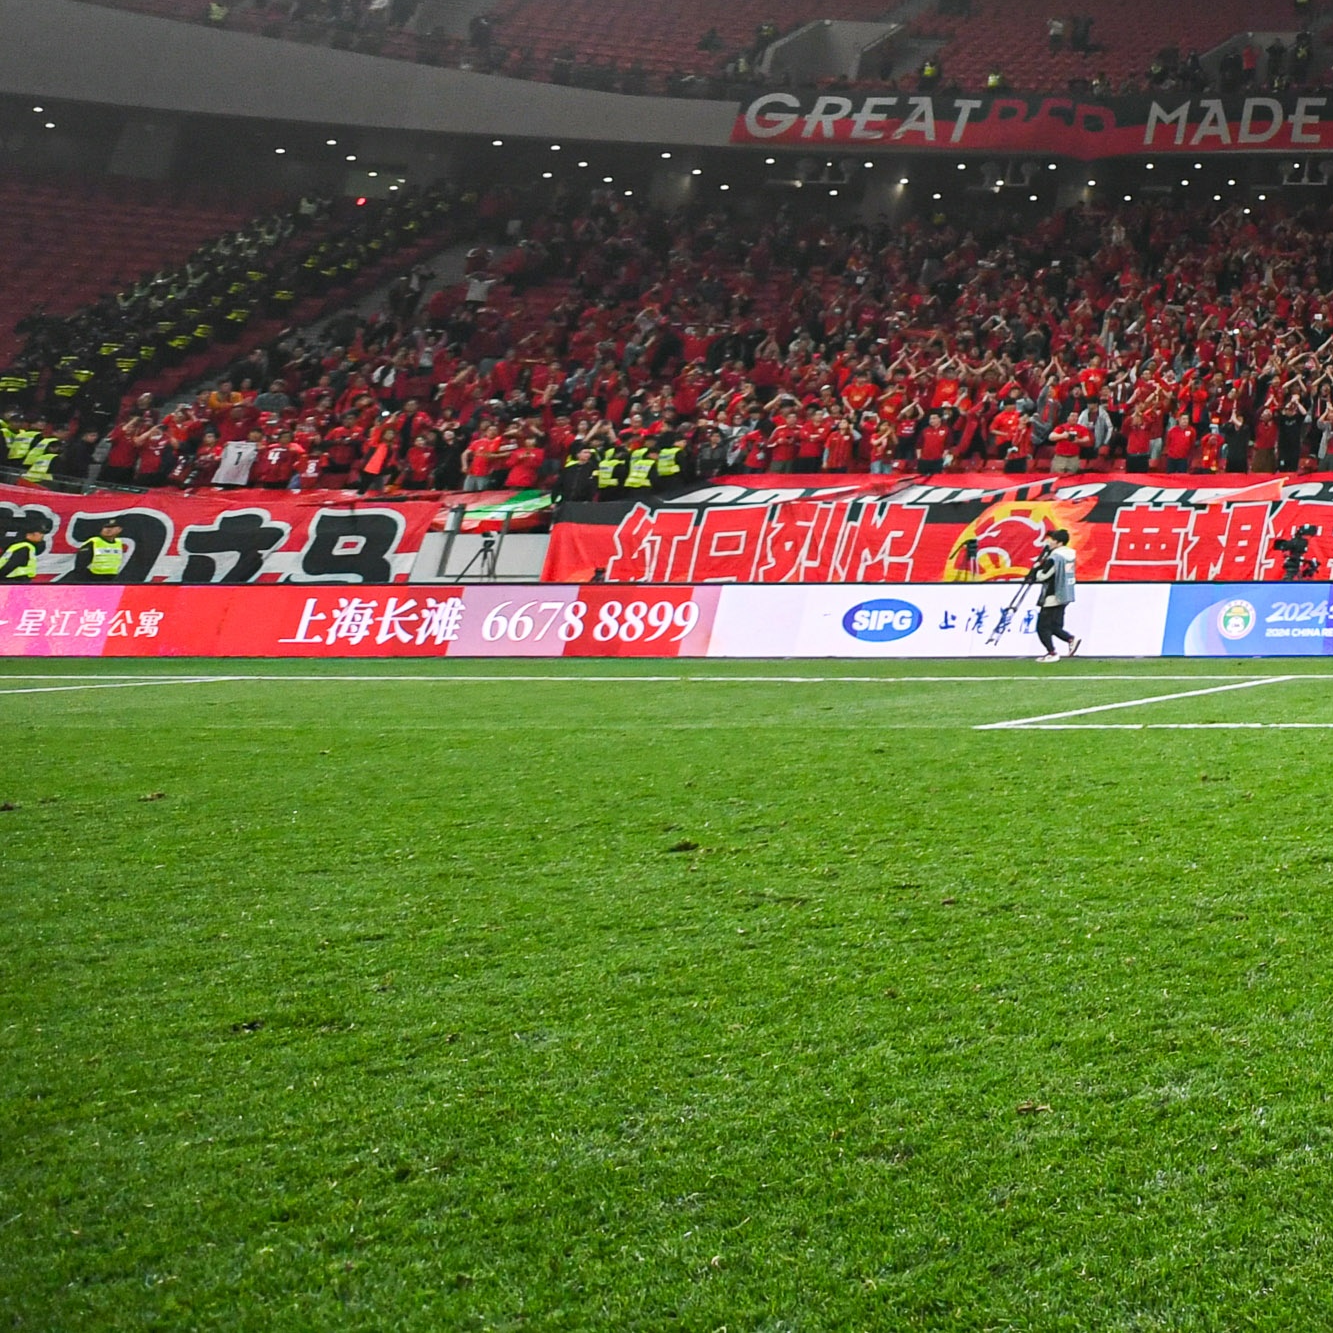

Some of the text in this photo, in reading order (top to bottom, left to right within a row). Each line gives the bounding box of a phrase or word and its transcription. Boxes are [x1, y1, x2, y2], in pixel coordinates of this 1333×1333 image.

[744, 93, 982, 143] GREAT
[1143, 96, 1327, 145] MADE
[15, 608, 164, 638] 星江湾公寓
[279, 597, 466, 645] 上海长滩
[481, 600, 699, 642] 6678 8899
[851, 609, 914, 631] SIPG
[1265, 627, 1291, 638] 2024
[1292, 627, 1320, 638] CHINA
